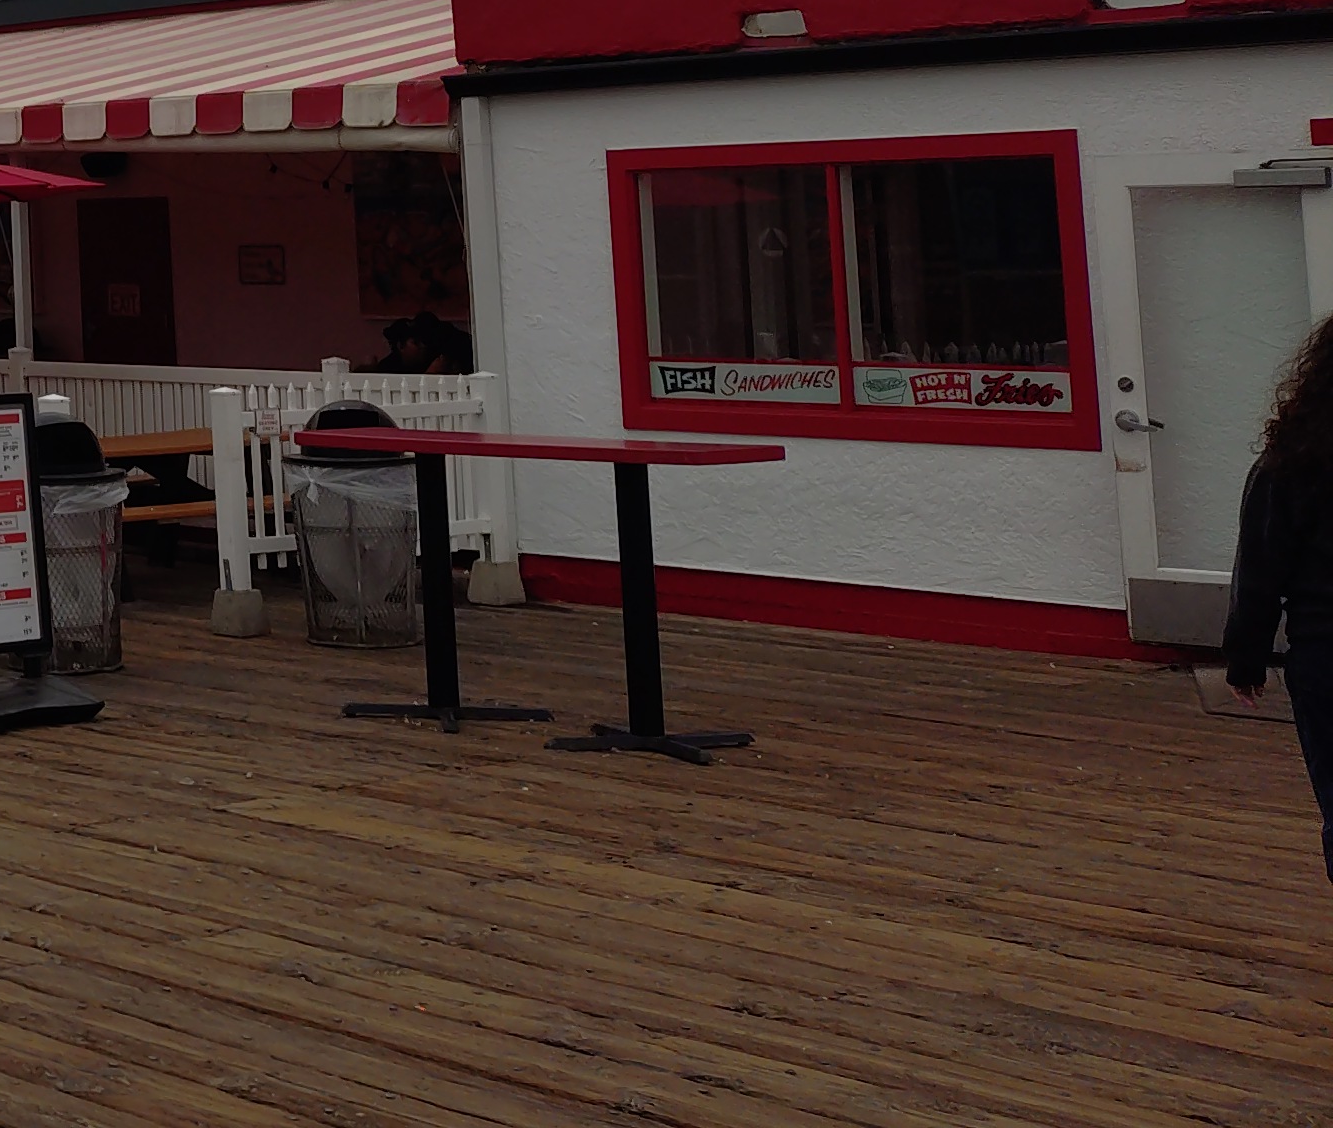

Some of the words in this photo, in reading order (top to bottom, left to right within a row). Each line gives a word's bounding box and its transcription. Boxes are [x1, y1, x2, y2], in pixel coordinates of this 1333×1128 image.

[111, 293, 138, 314] EXIT
[665, 368, 714, 392] FISH
[720, 369, 837, 396] SANDWICHES
[914, 373, 951, 388] HOT
[975, 373, 1063, 407] Fries
[916, 386, 970, 403] FRESH
